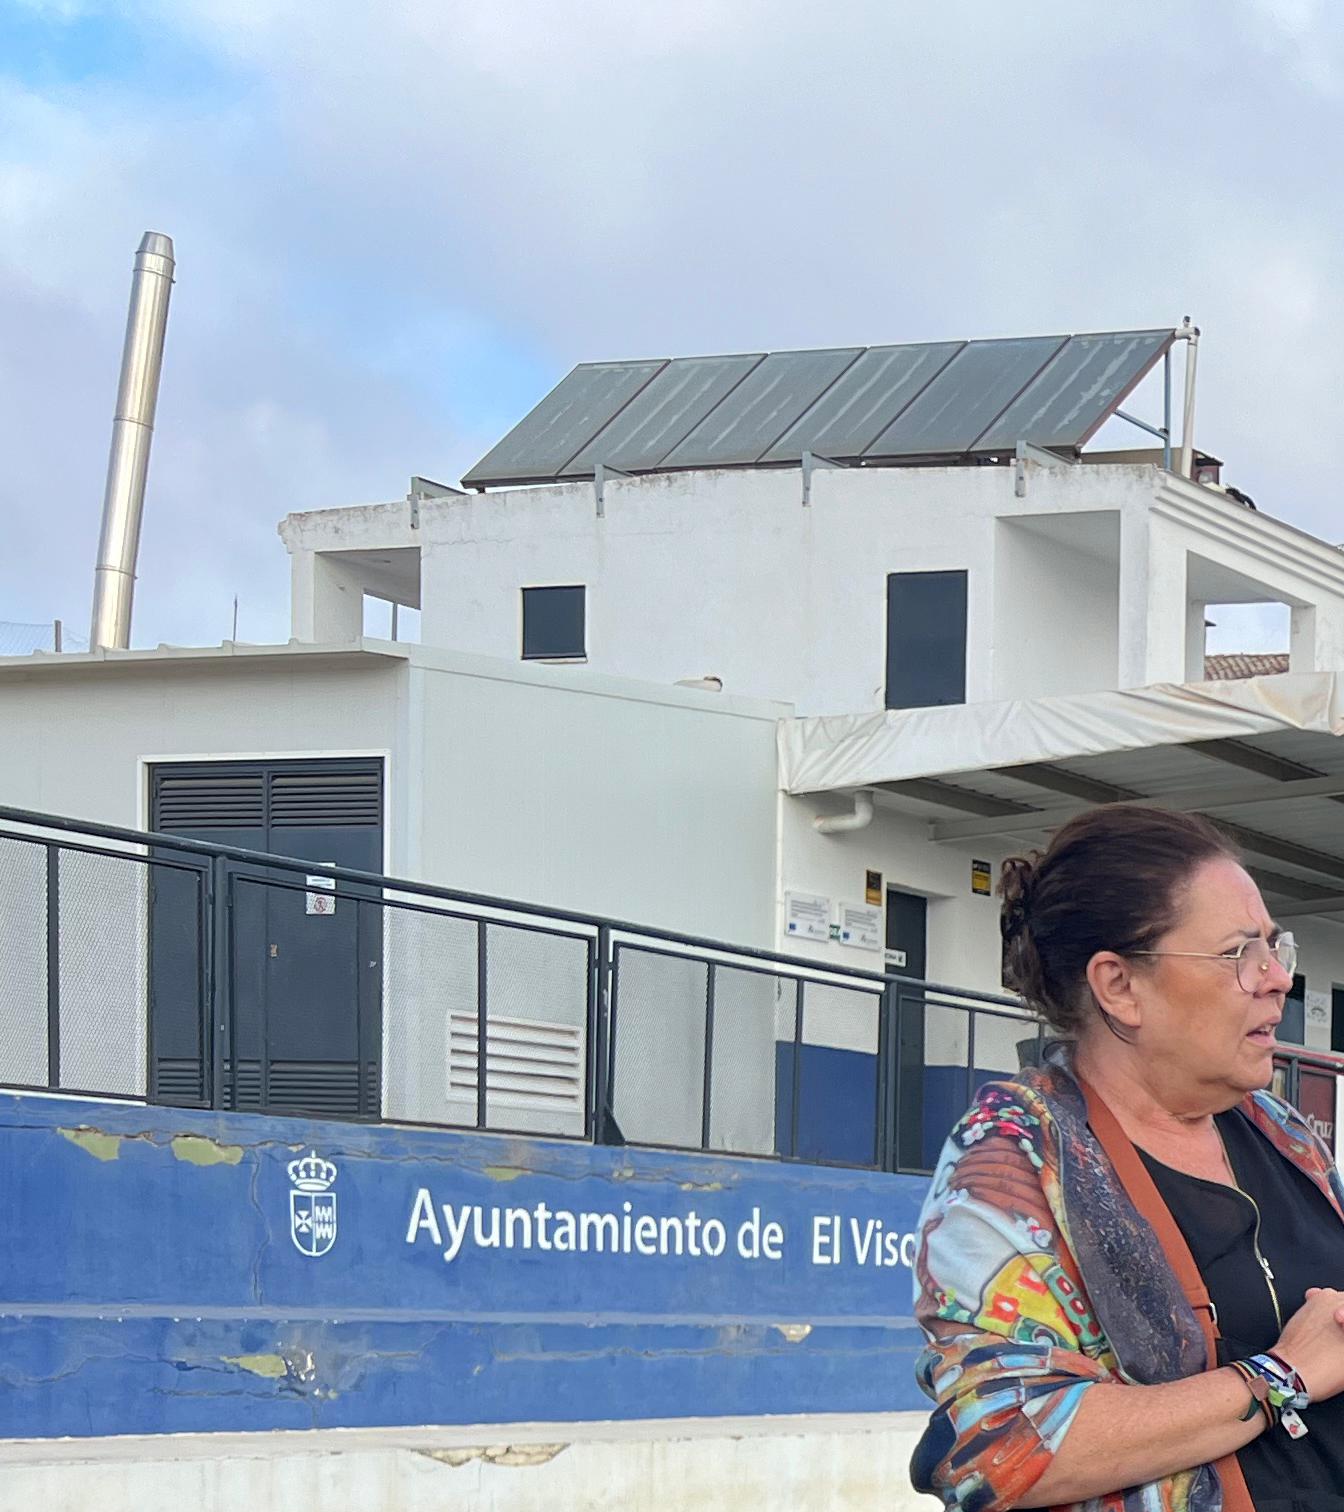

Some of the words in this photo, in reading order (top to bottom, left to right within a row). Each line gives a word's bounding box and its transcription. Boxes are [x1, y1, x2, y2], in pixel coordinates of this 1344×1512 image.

[405, 1187, 727, 1262] Ayuntamiento
[737, 1207, 784, 1260] de
[812, 1215, 841, 1265] El
[850, 1217, 916, 1268] Viso
